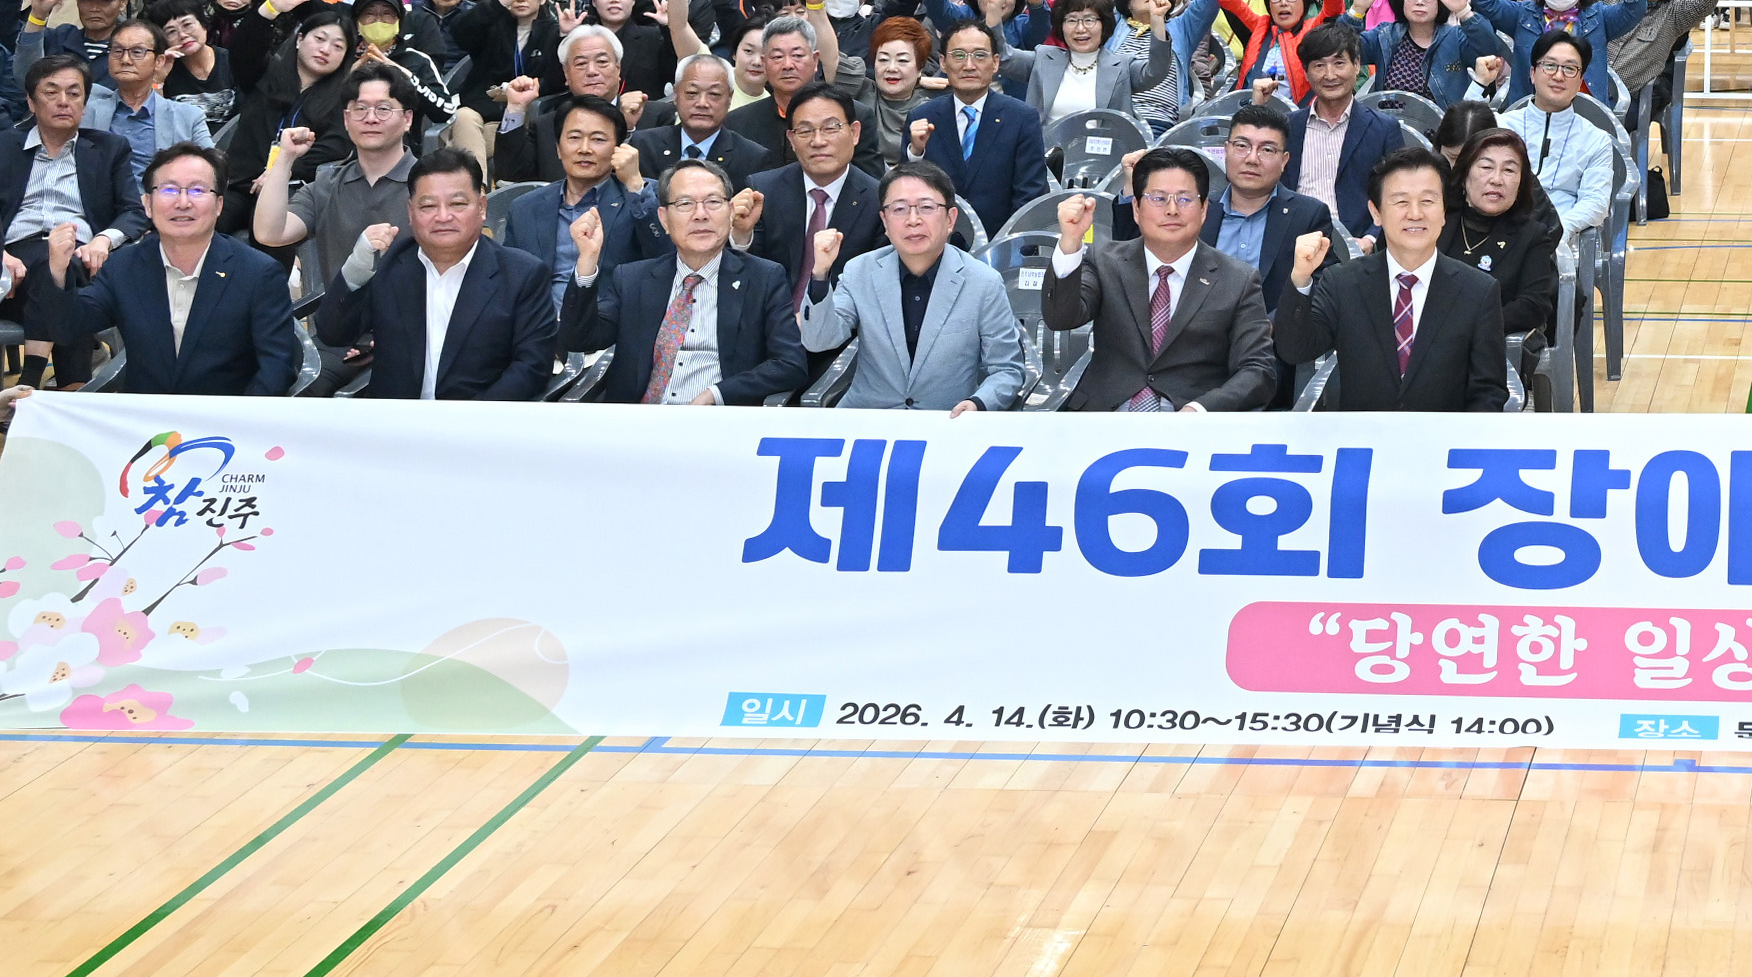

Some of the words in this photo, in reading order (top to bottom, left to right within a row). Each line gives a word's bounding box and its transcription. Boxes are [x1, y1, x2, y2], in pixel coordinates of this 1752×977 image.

[218, 483, 252, 494] JINJU
[221, 473, 265, 484] CHARM
[135, 476, 204, 528] 참
[196, 496, 260, 529] 진주
[742, 438, 1373, 578] 제46회
[1308, 611, 1588, 686] “당연한
[741, 698, 807, 725] 일시
[836, 702, 929, 727] 2026.
[943, 705, 973, 727] 4.
[991, 704, 1095, 730] 14.(화)
[1450, 715, 1554, 736] 14:00)
[1634, 719, 1702, 738] 장소
